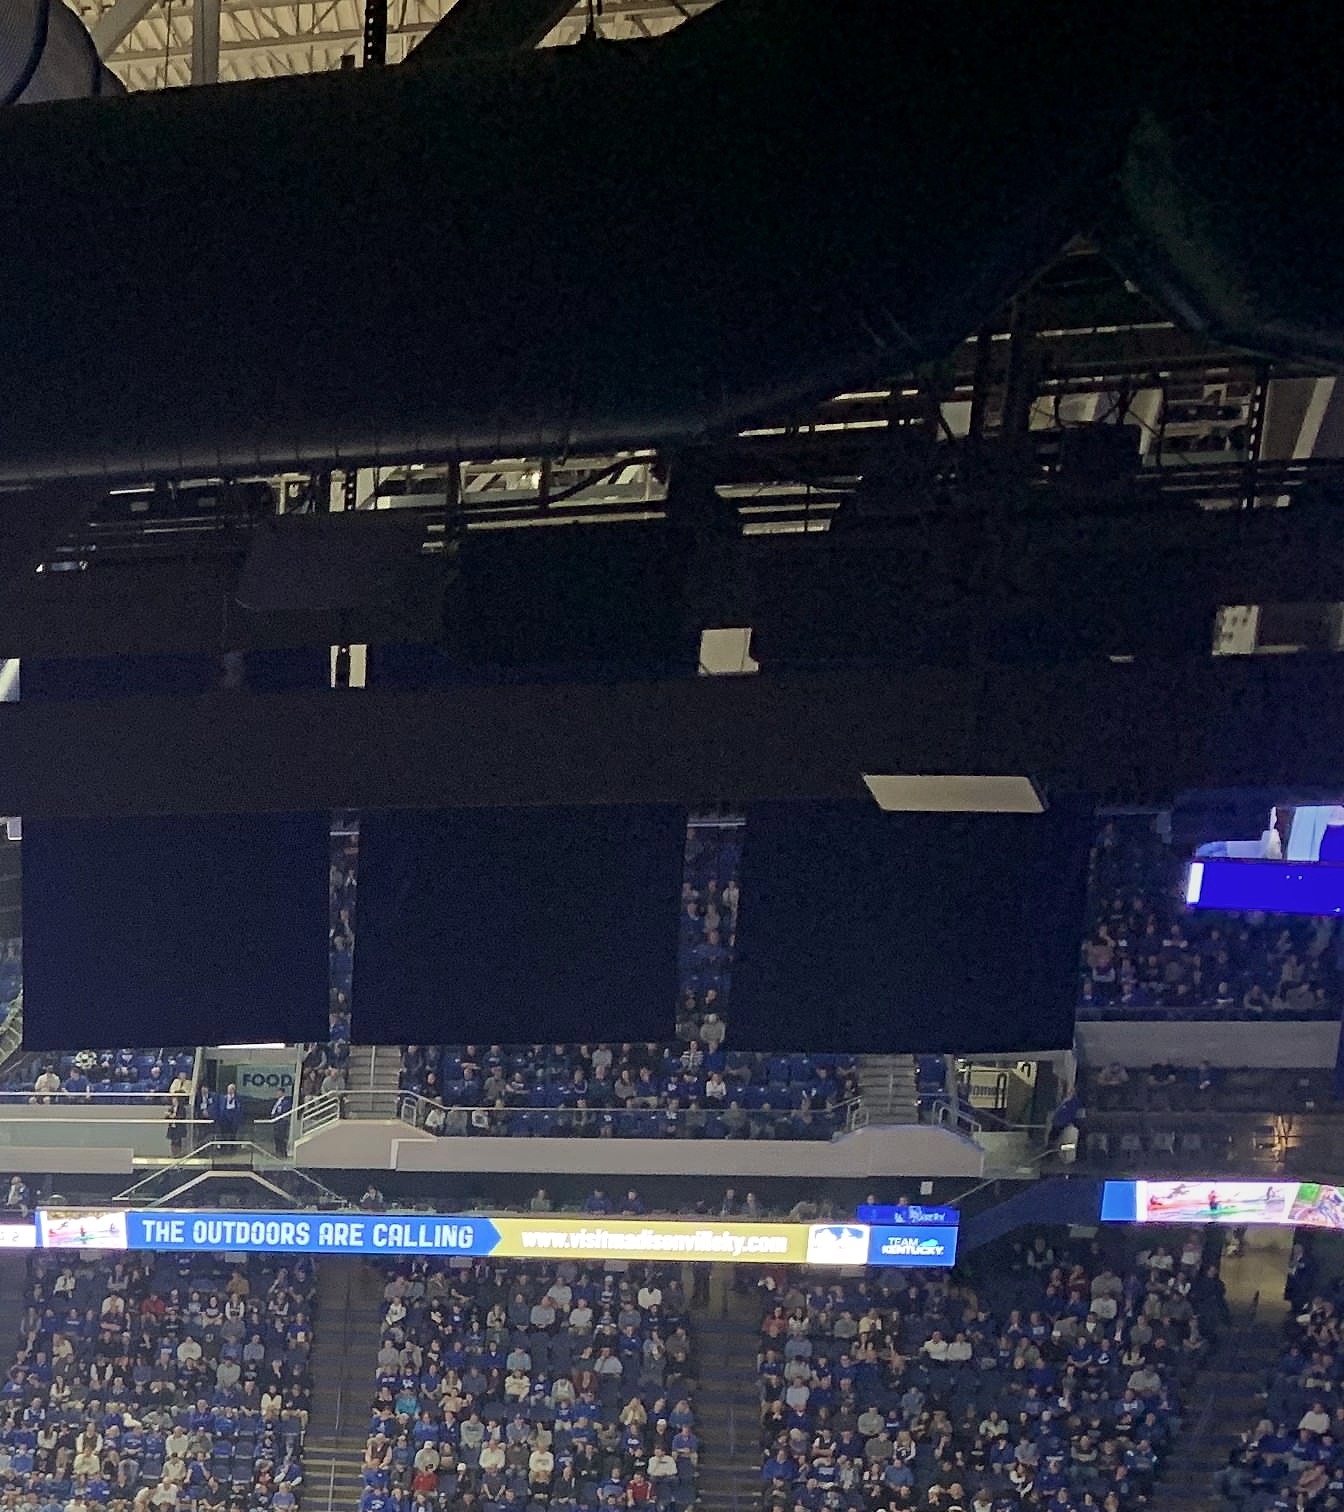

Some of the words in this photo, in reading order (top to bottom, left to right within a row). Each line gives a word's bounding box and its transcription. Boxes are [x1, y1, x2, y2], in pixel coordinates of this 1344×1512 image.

[243, 1073, 292, 1087] FOOD
[142, 1219, 185, 1243] THE
[193, 1219, 310, 1245] OUTDOORS
[319, 1223, 364, 1246] ARE
[373, 1223, 474, 1248] CALLING
[887, 1237, 919, 1246] TEAM
